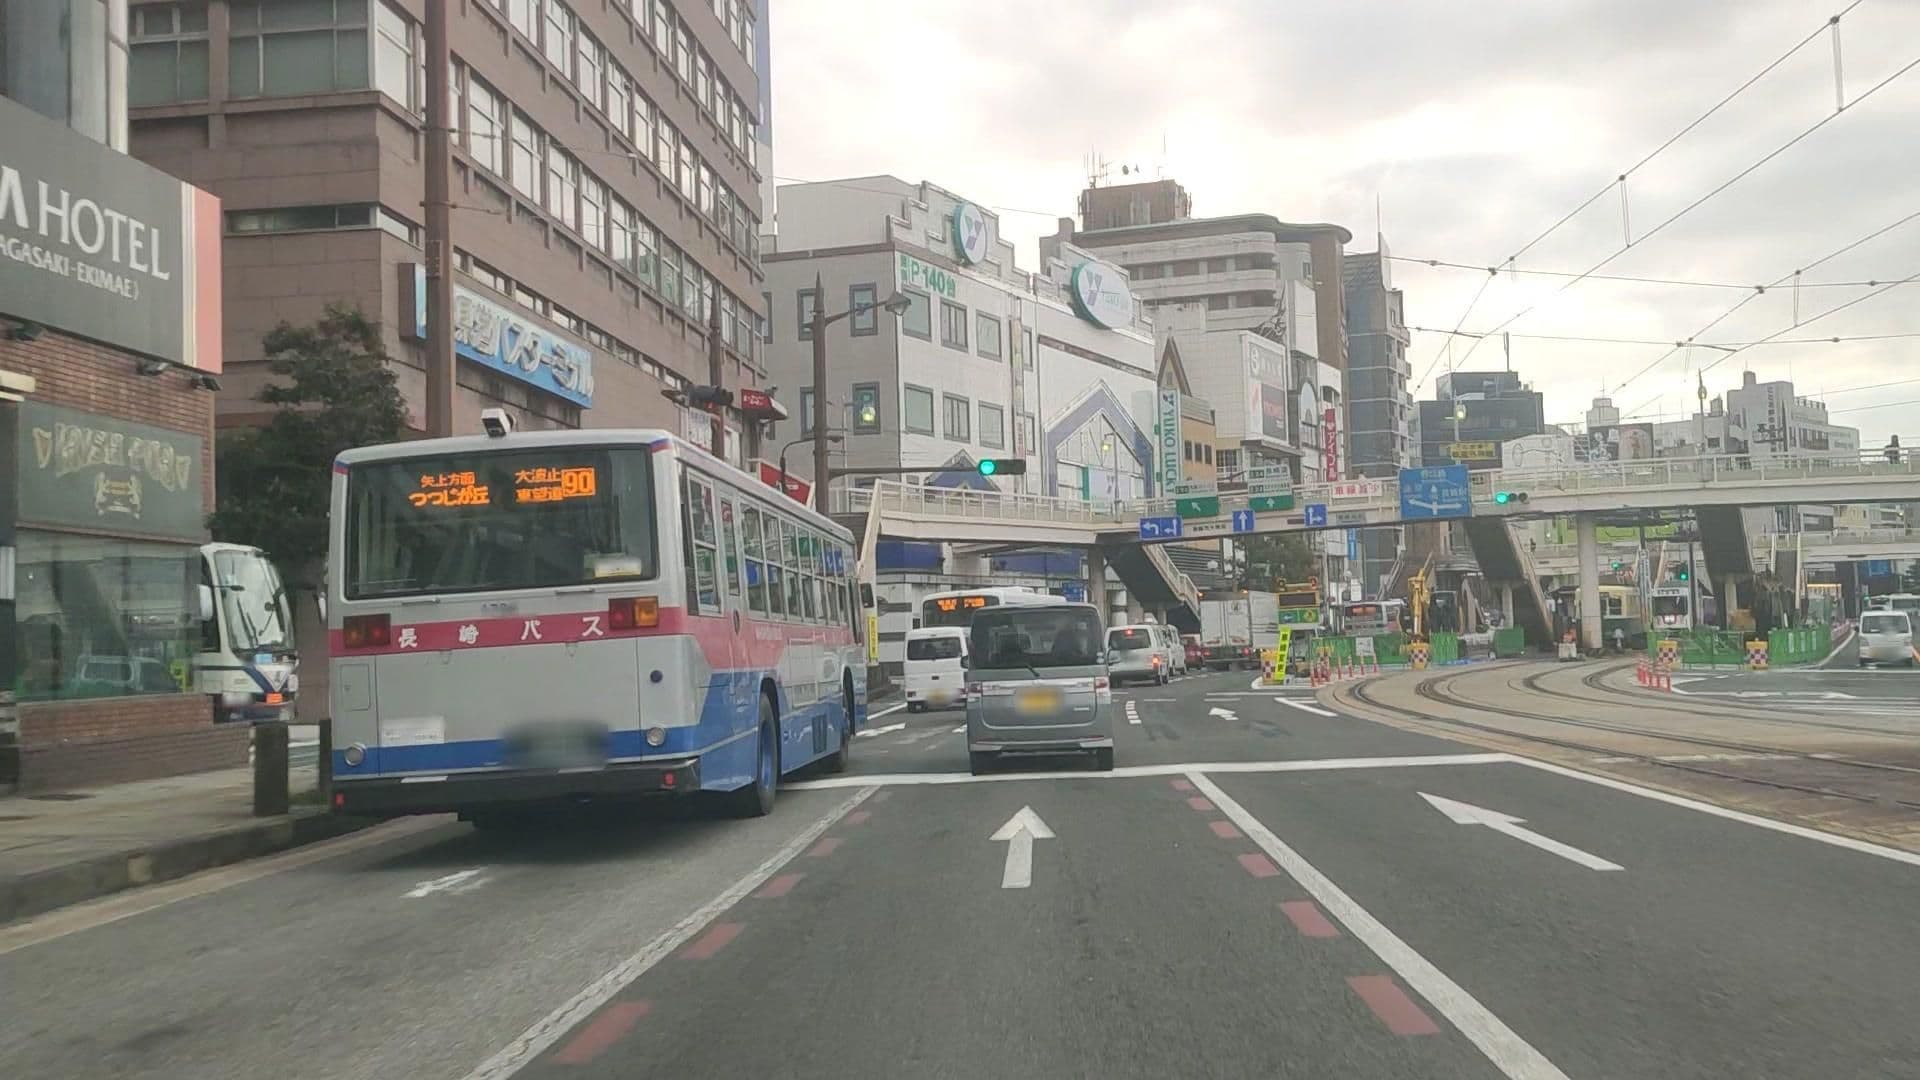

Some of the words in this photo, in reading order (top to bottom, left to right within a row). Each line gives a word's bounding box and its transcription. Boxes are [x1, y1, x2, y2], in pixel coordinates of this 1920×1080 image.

[38, 180, 170, 280] HOTEL
[1163, 409, 1176, 448] YUKO
[421, 471, 475, 488] 矢上方面
[564, 470, 592, 494] 90
[409, 486, 490, 506] つつじが丘
[398, 615, 603, 649] 長崎バス
